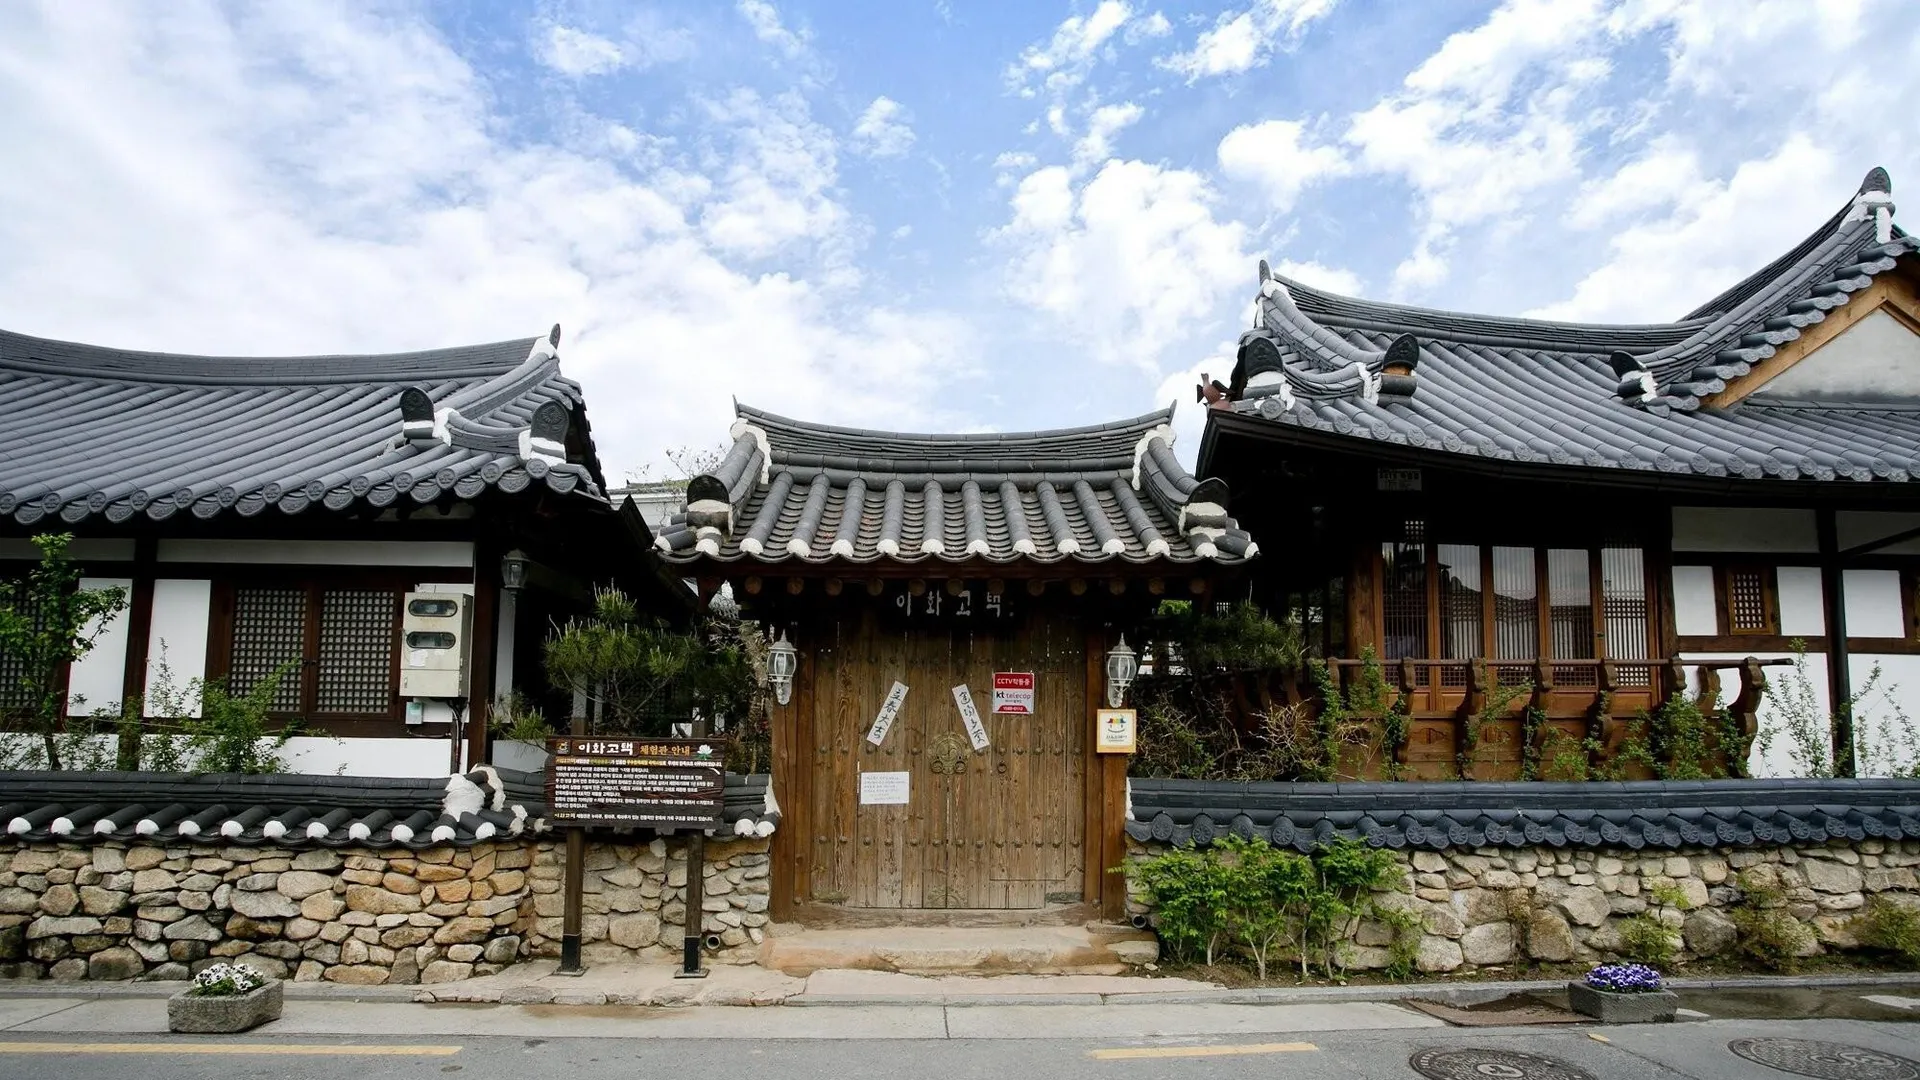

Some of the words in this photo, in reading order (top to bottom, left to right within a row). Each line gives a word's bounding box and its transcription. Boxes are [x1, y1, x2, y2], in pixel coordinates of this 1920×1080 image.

[896, 590, 1001, 618] 이화고택
[996, 691, 1005, 699] kt
[1006, 692, 1031, 700] telecop
[874, 689, 901, 739] 立春大吉
[578, 742, 634, 756] 이화고택
[640, 745, 668, 755] 체험관
[671, 745, 691, 756] 안내
